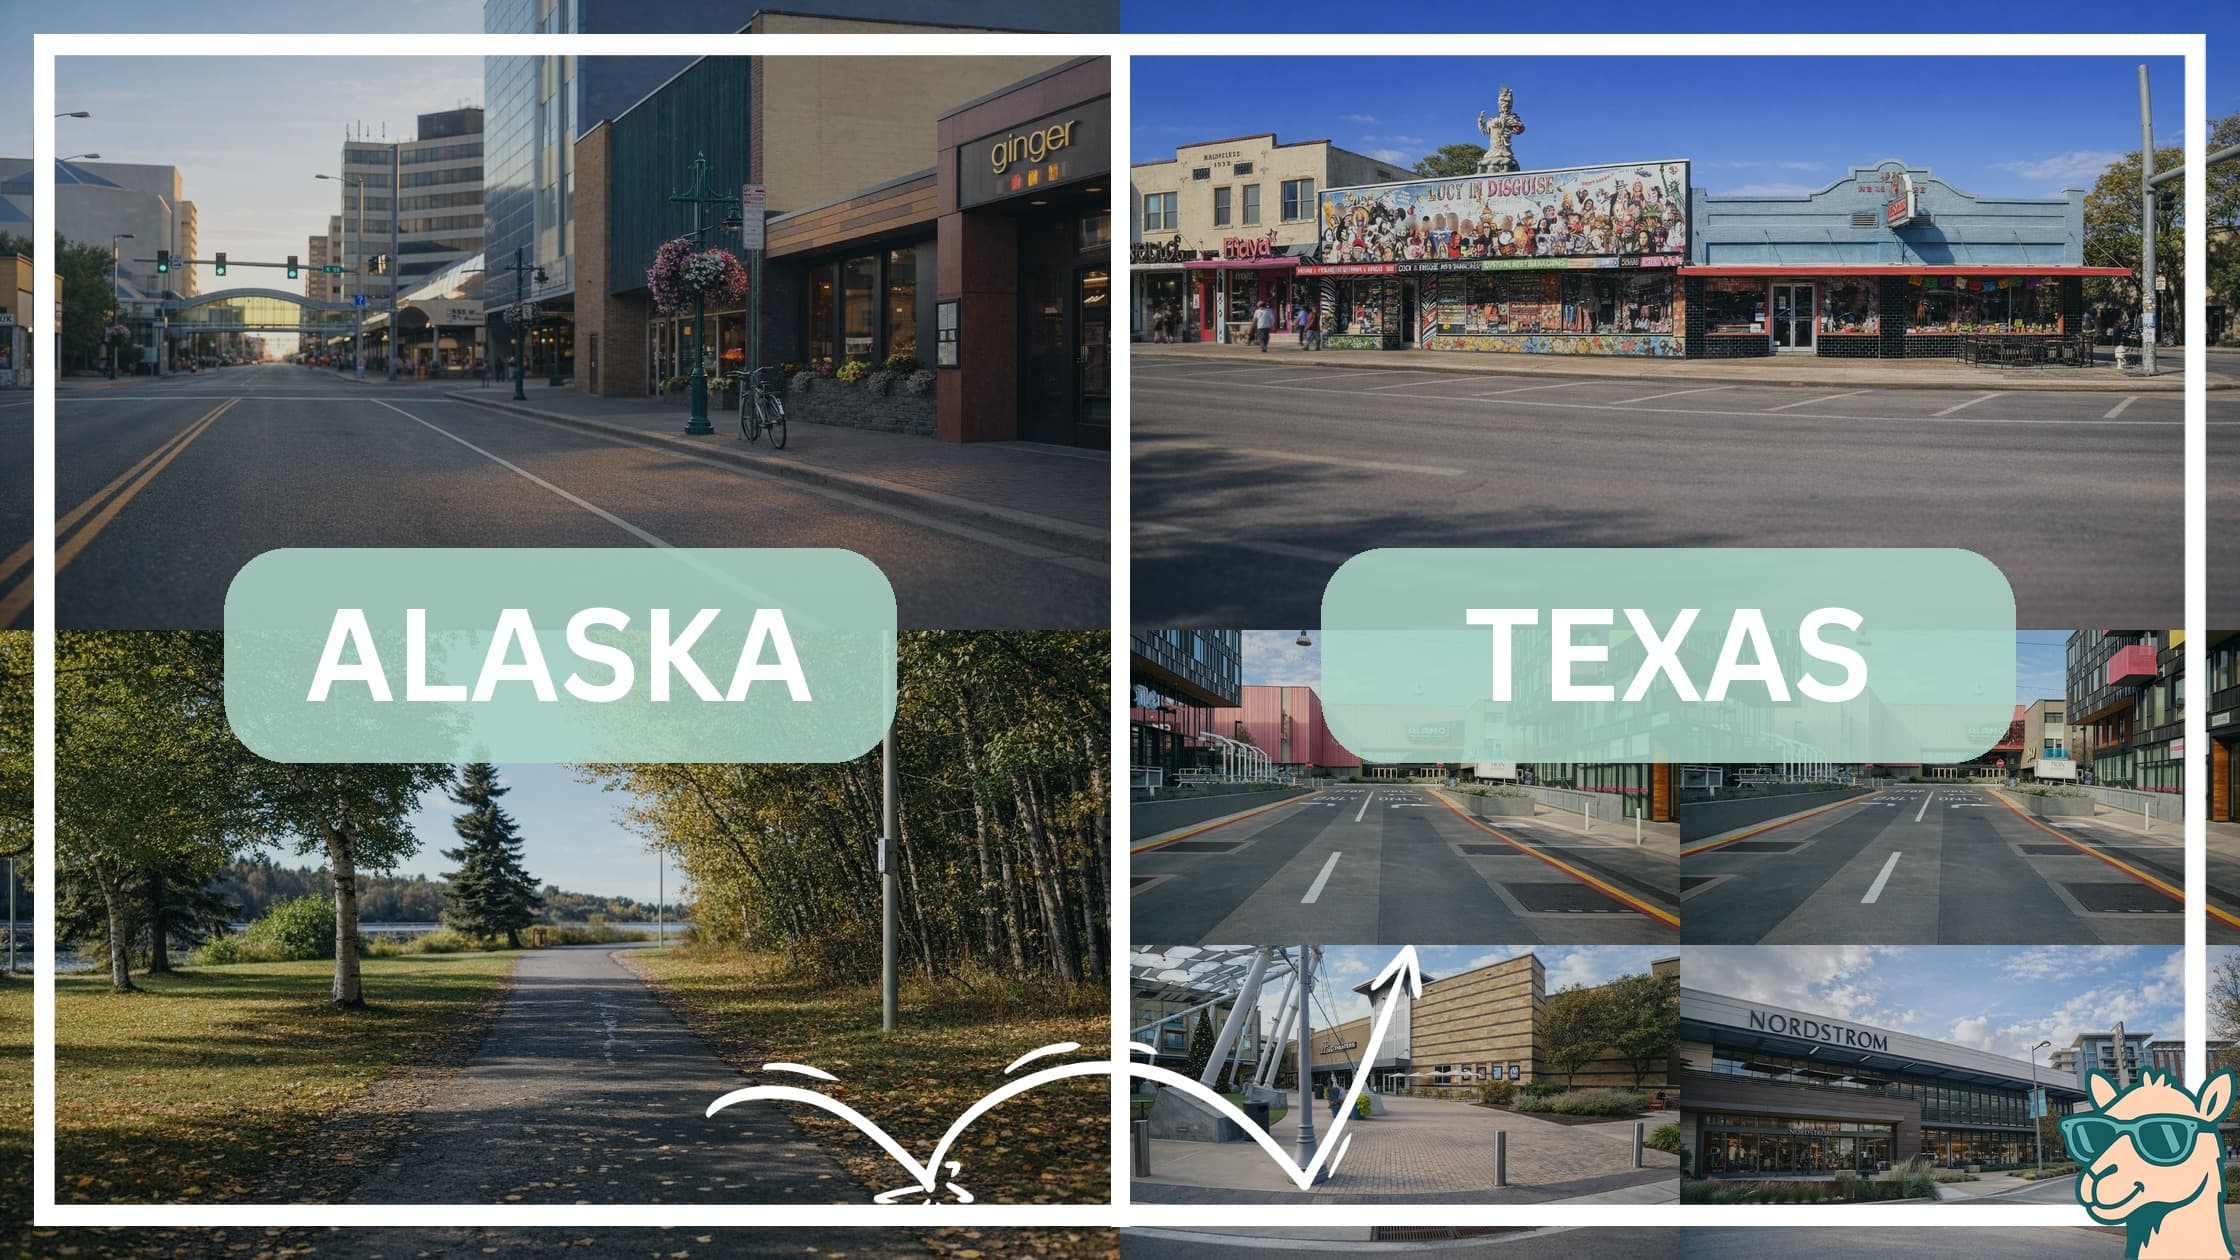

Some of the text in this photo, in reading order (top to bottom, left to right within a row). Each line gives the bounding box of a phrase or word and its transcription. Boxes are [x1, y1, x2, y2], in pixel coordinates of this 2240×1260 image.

[991, 120, 1075, 174] ginger
[1427, 183, 1464, 201] LUCY
[1469, 181, 1483, 200] IN
[1487, 176, 1555, 198] DISGUISE
[1750, 1009, 1888, 1052] NORDSTROM
